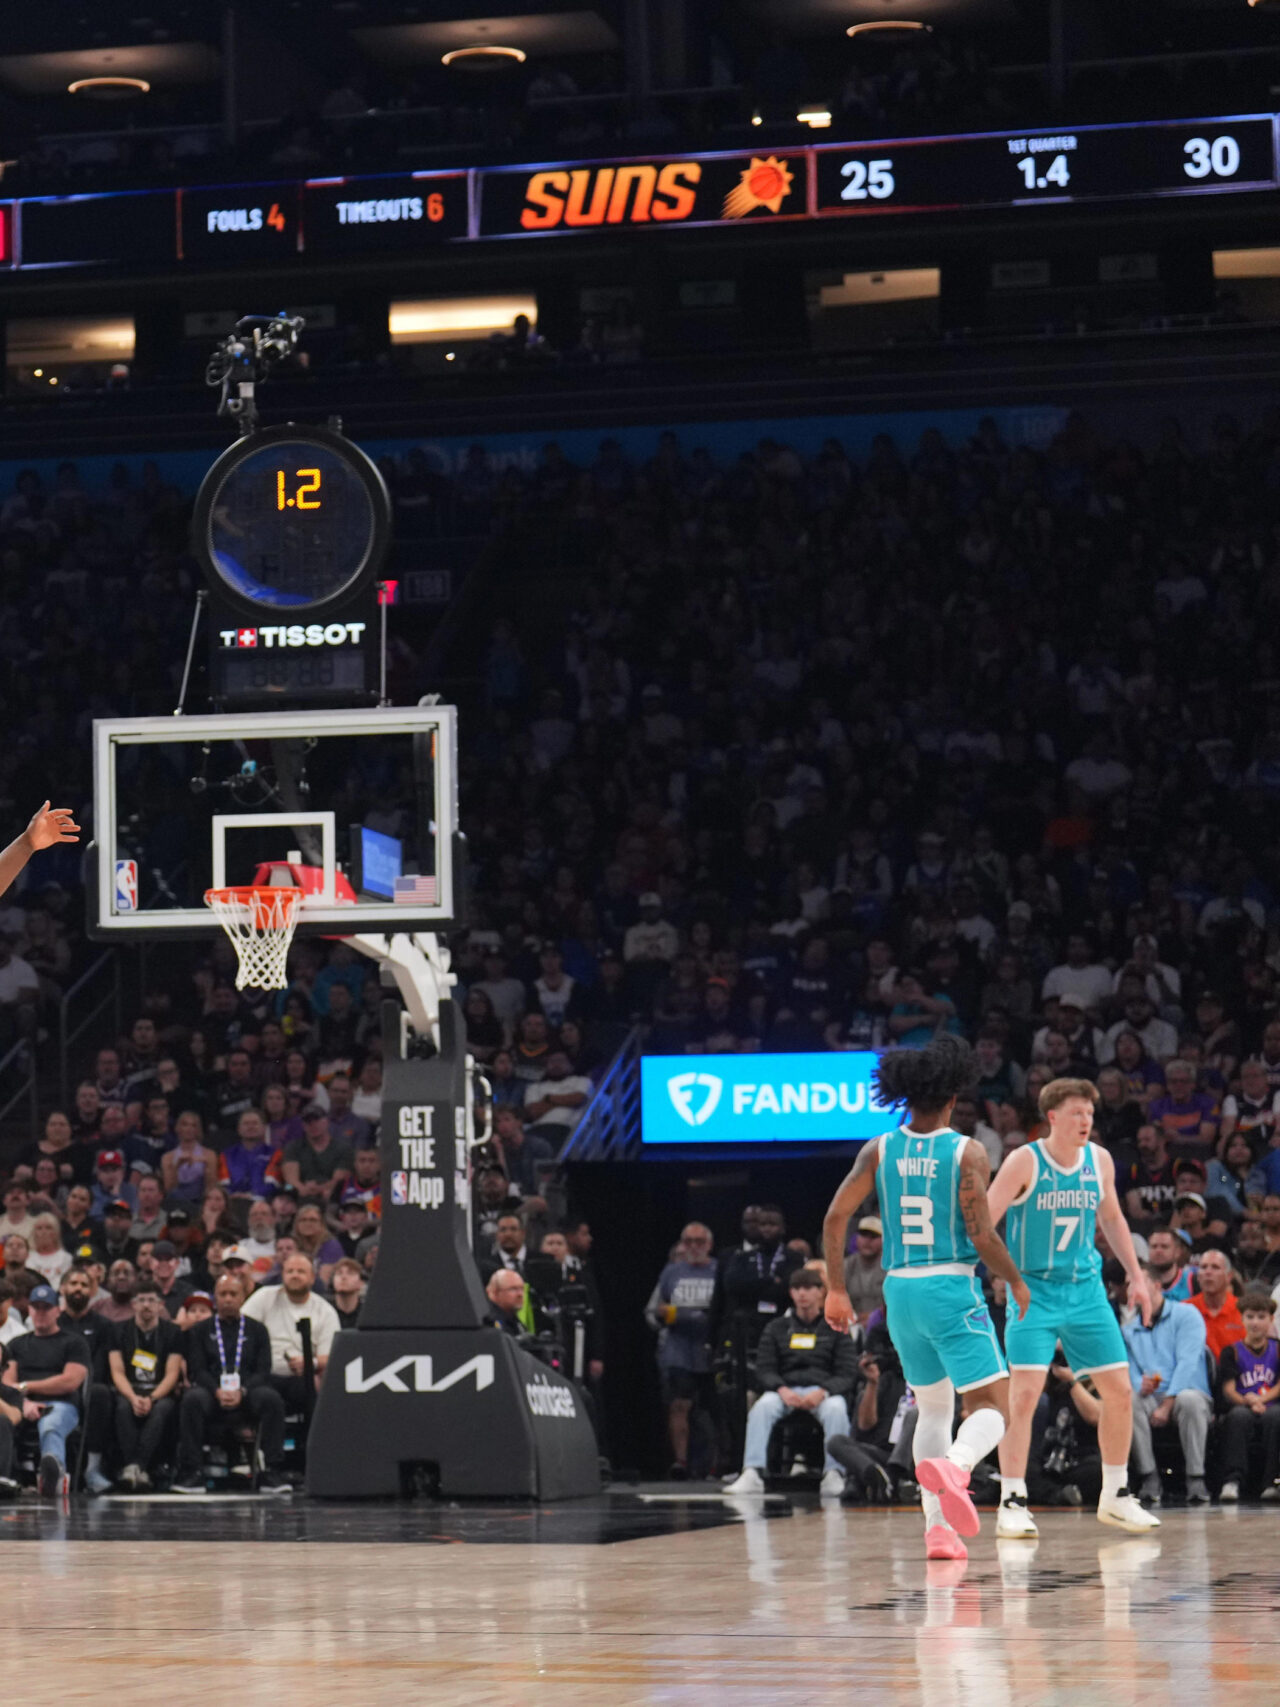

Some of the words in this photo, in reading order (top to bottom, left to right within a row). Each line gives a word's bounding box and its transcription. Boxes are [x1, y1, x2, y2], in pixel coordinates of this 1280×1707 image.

[1017, 154, 1070, 188] 1.4
[1183, 136, 1240, 178] 30
[521, 162, 701, 229] SUNS
[840, 159, 895, 200] 25
[207, 208, 262, 233] FOULS
[267, 204, 285, 231] 4
[336, 198, 422, 224] TIMEOUTS
[427, 193, 444, 221] 6
[277, 468, 322, 511] 1.2
[259, 623, 366, 647] TISSOT
[399, 1105, 435, 1138] GET
[398, 1138, 436, 1170] THE
[895, 1156, 940, 1179] WHITE
[408, 1170, 445, 1210] App
[1036, 1188, 1098, 1212] HORNETS
[900, 1195, 935, 1246] 3
[1054, 1216, 1080, 1252] 7
